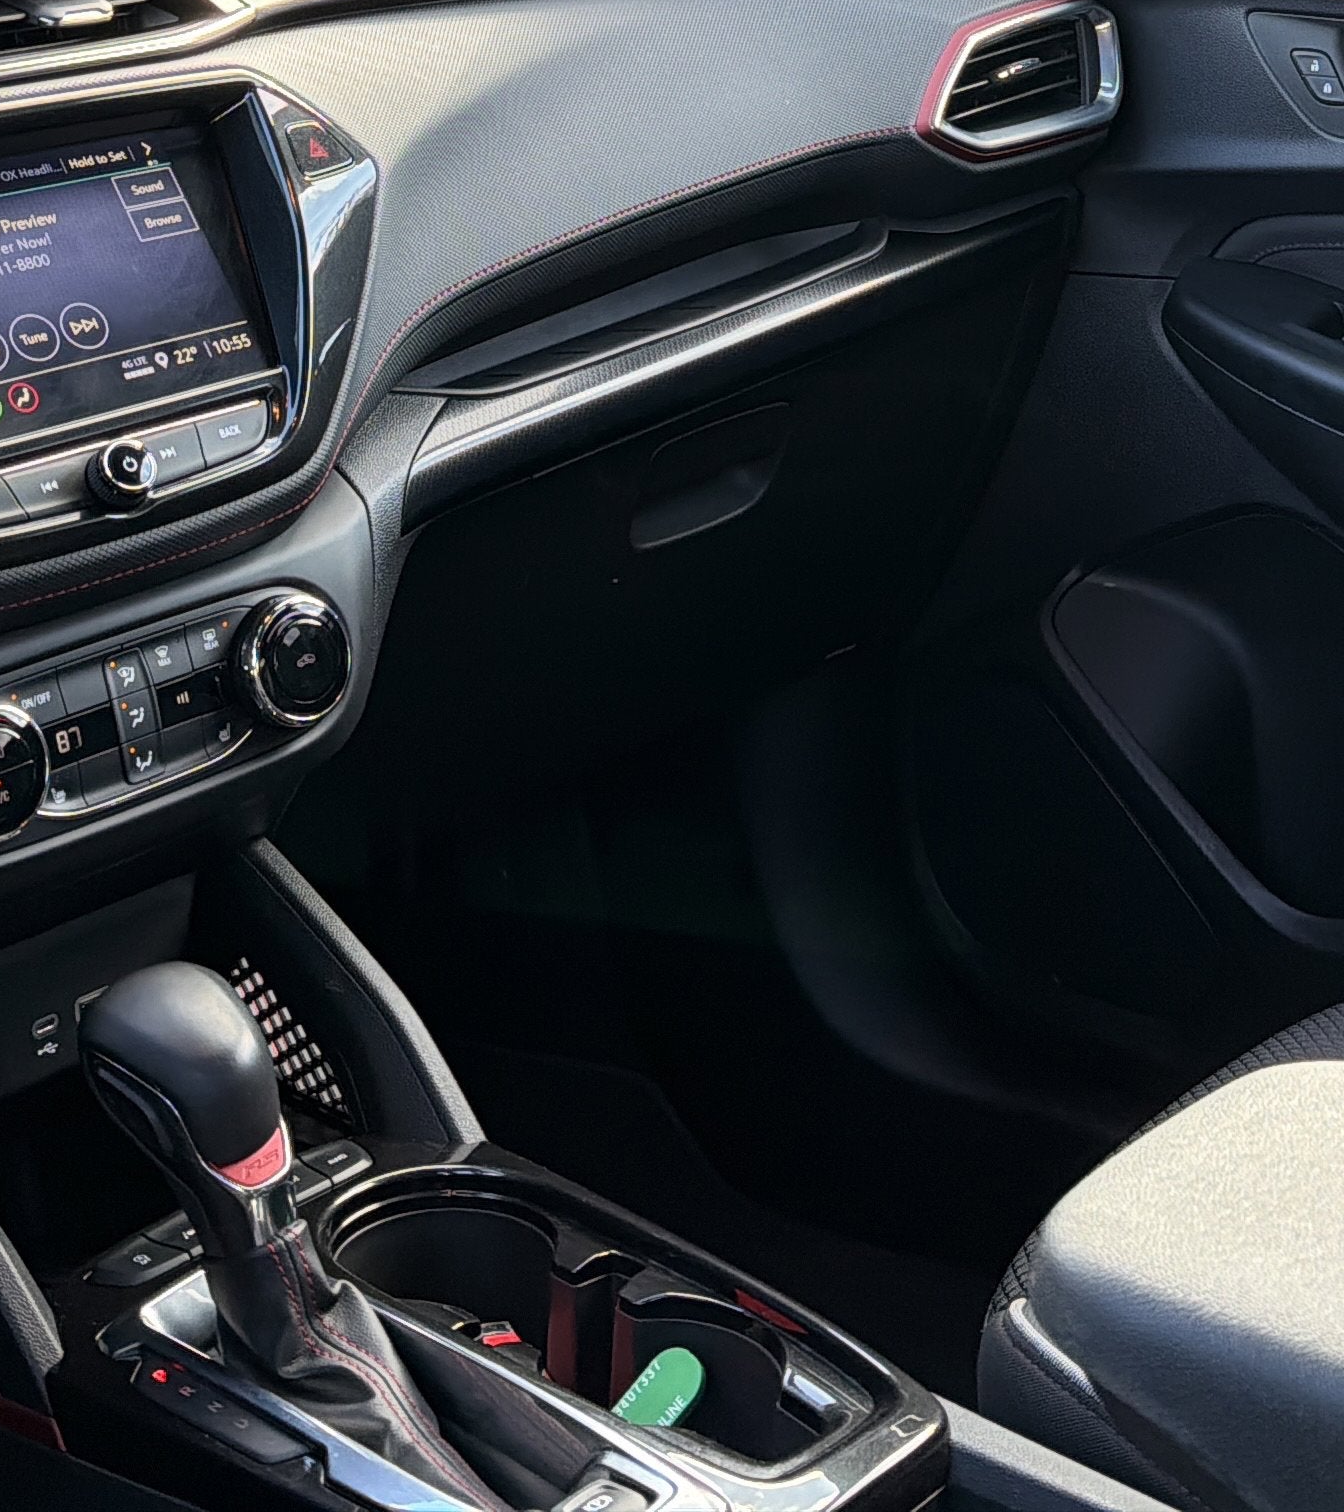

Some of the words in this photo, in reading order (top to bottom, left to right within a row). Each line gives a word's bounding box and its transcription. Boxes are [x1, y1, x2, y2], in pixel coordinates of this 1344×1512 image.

[68, 155, 94, 170] Hold
[95, 154, 106, 165] to
[108, 149, 128, 163] Set
[130, 180, 165, 196] Sound
[0, 211, 58, 235] Preview
[144, 212, 184, 230] Browse
[17, 232, 52, 251] Now!
[19, 330, 49, 347] Tune
[212, 333, 252, 356] 10:55
[121, 358, 134, 370] 4G
[134, 354, 149, 367] LTE
[218, 424, 241, 439] BACK
[21, 691, 52, 710] ON/OFF
[55, 726, 83, 754] 87
